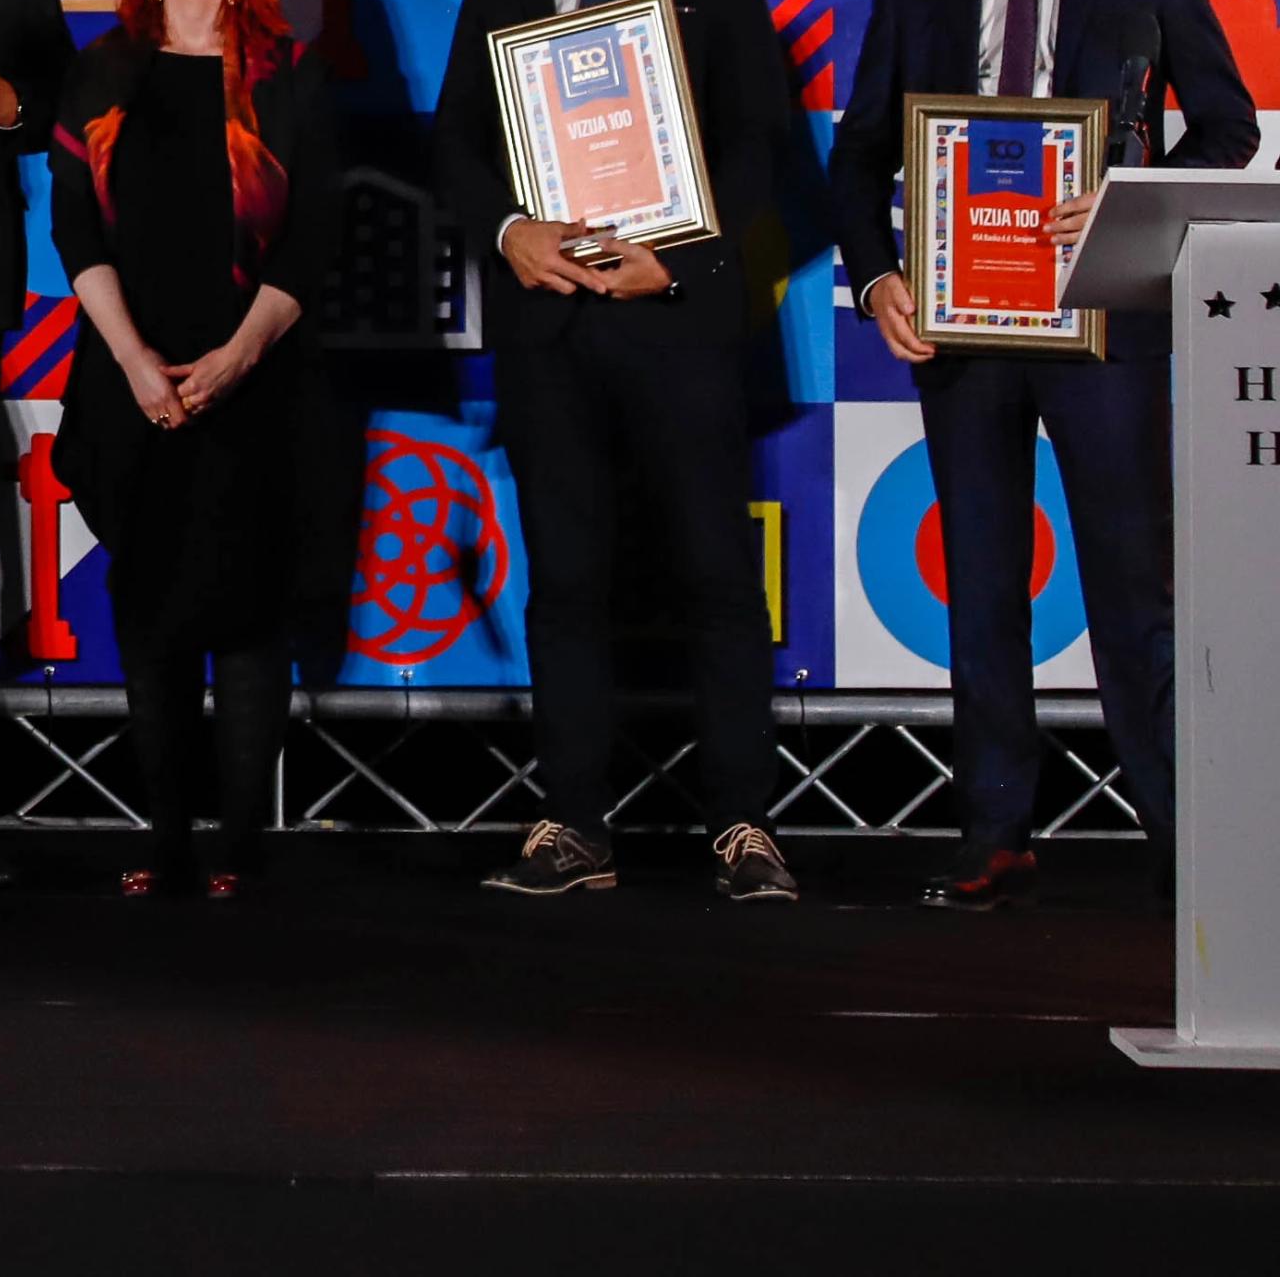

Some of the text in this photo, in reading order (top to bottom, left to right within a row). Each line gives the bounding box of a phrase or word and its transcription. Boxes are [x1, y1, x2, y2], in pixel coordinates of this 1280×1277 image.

[567, 109, 633, 141] VIZIJA 100
[969, 207, 1039, 228] VIZIJA 100
